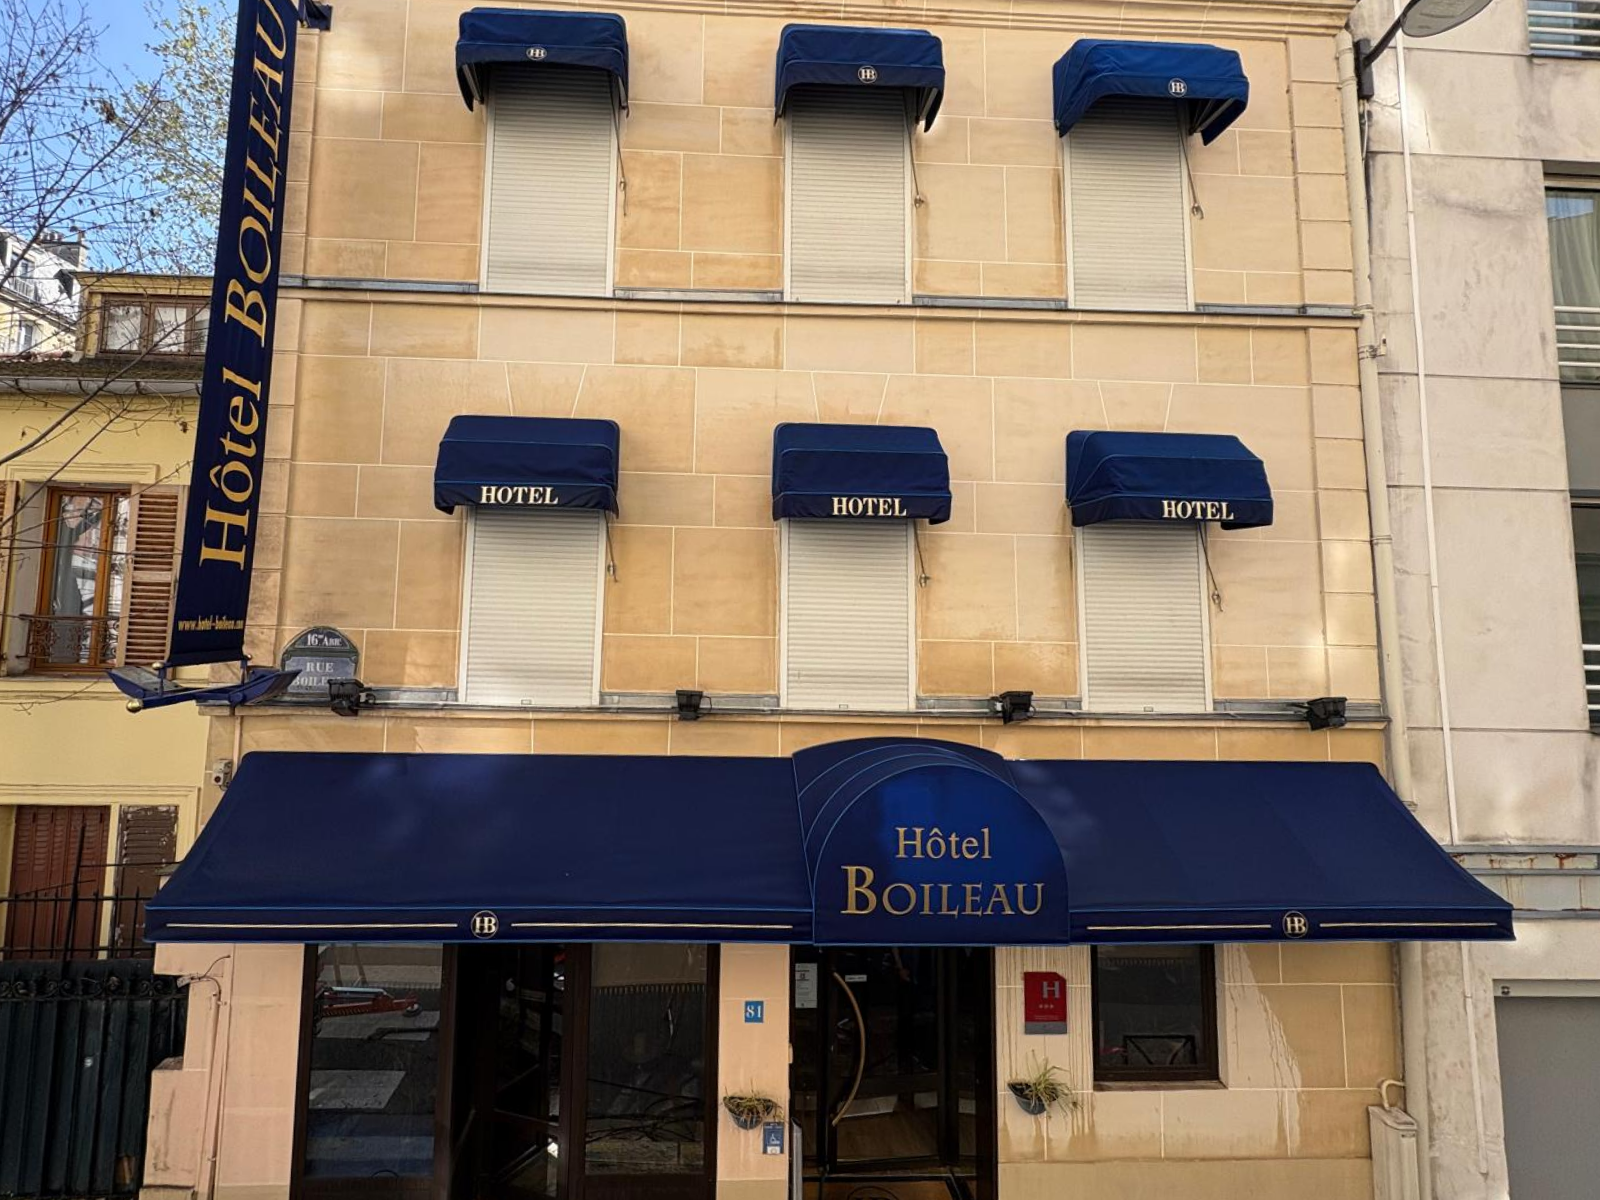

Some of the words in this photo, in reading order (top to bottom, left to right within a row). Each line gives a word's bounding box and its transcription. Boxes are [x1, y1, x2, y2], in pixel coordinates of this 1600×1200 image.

[224, 0, 287, 346] BOILEAU
[199, 366, 262, 571] Hôtel
[480, 486, 559, 505] HOTEL
[831, 496, 907, 517] HOTEL
[1162, 500, 1234, 520] HOTEL
[306, 662, 334, 673] RUE
[894, 827, 993, 859] Hôtel
[840, 865, 1045, 918] BOILEAU
[473, 914, 498, 935] HB
[1284, 914, 1307, 935] HB
[1042, 981, 1060, 999] H
[745, 1004, 761, 1019] 81
